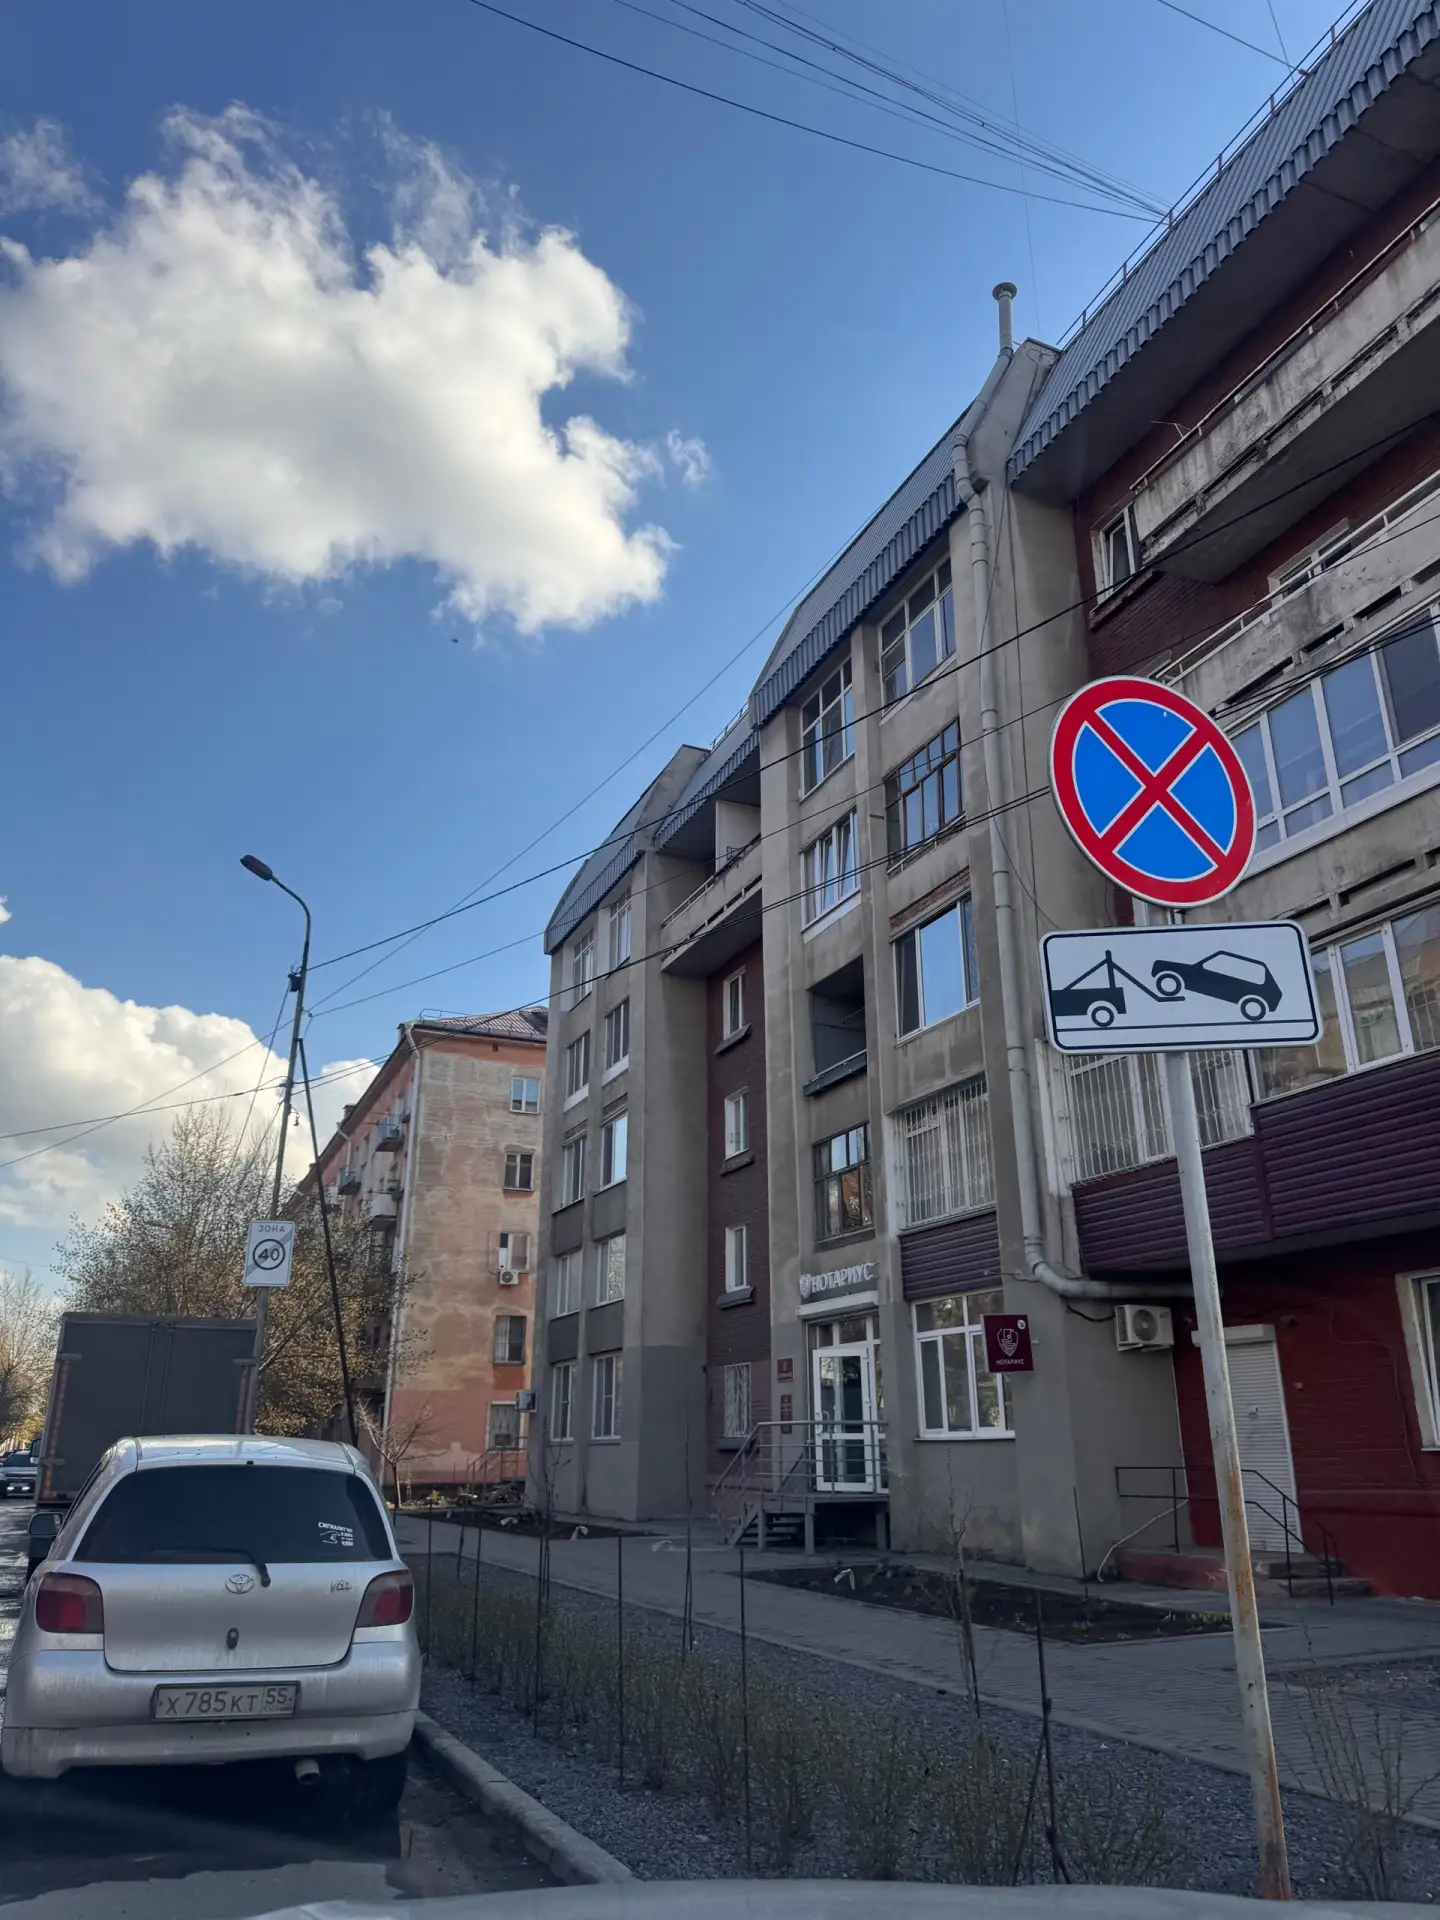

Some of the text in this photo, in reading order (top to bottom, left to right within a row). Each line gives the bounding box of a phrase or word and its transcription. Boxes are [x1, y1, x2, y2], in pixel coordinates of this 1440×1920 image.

[257, 1224, 285, 1233] ЗОНА
[258, 1248, 280, 1261] 40
[811, 1262, 878, 1293] НОТАРИУС
[996, 1358, 1025, 1366] НОТАРИУС
